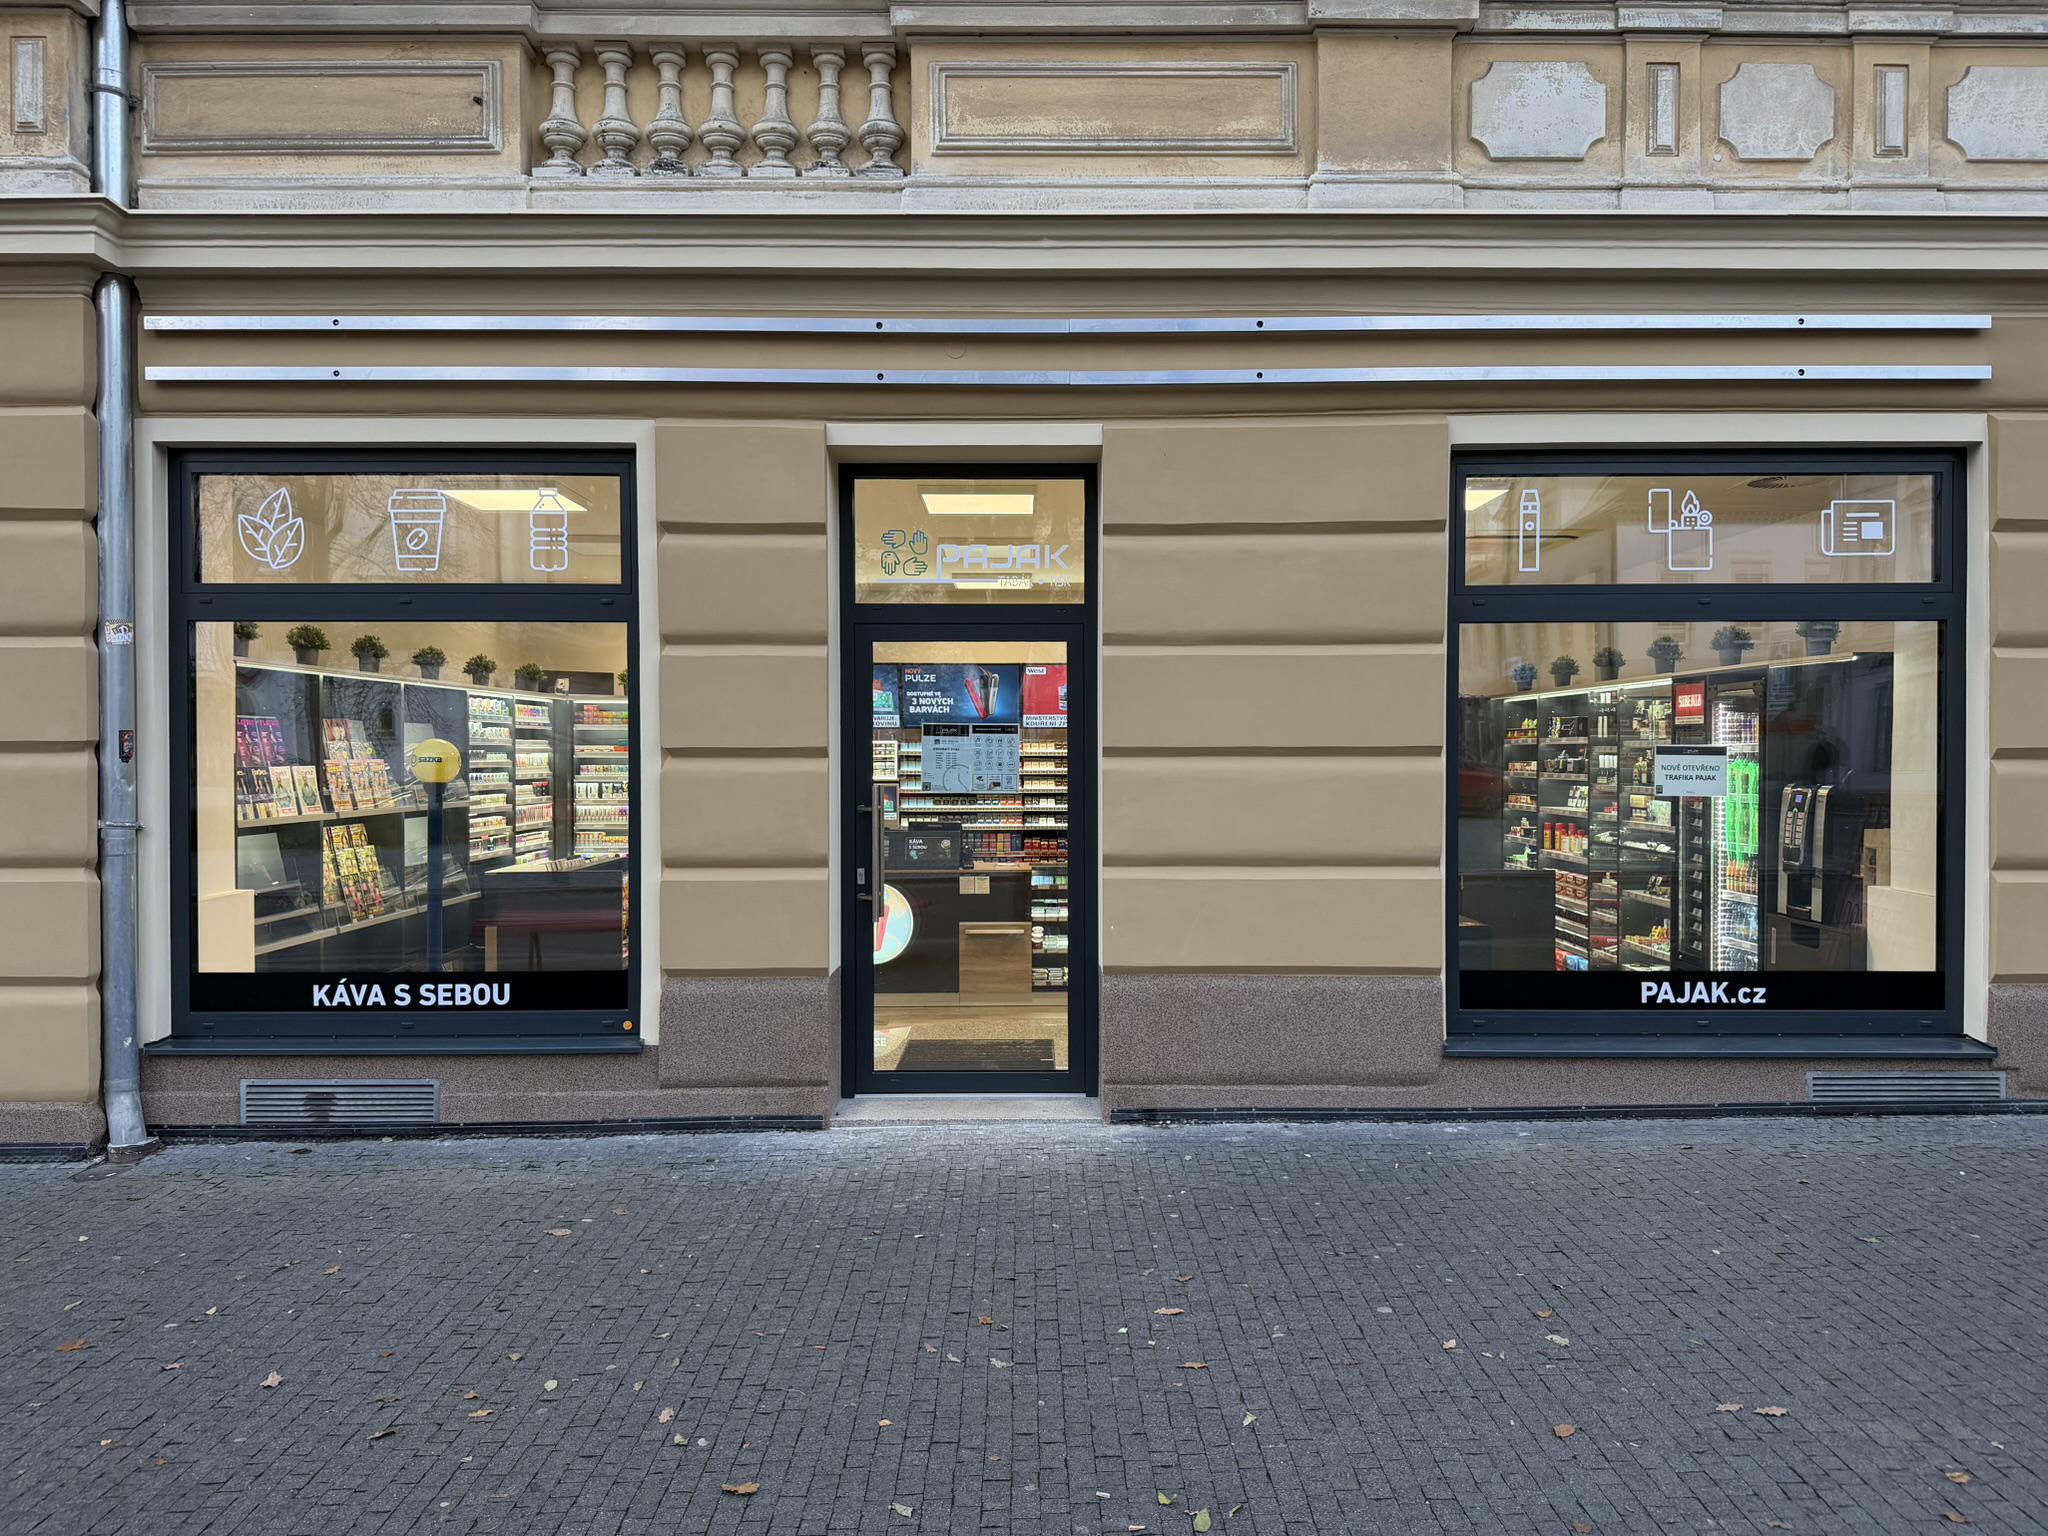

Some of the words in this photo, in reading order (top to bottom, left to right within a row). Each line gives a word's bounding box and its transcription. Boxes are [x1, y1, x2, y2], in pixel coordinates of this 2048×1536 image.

[936, 544, 1069, 580] PAJAK
[905, 674, 937, 682] PULZE
[919, 696, 953, 704] NOVÝCH
[910, 705, 950, 713] BARVÁCH
[1682, 763, 1720, 771] OTEVŘENO
[313, 978, 387, 1006] KÁVA
[394, 983, 411, 1006] S
[419, 983, 511, 1006] SEBOU
[1641, 981, 1767, 1004] PAJAK.cz
